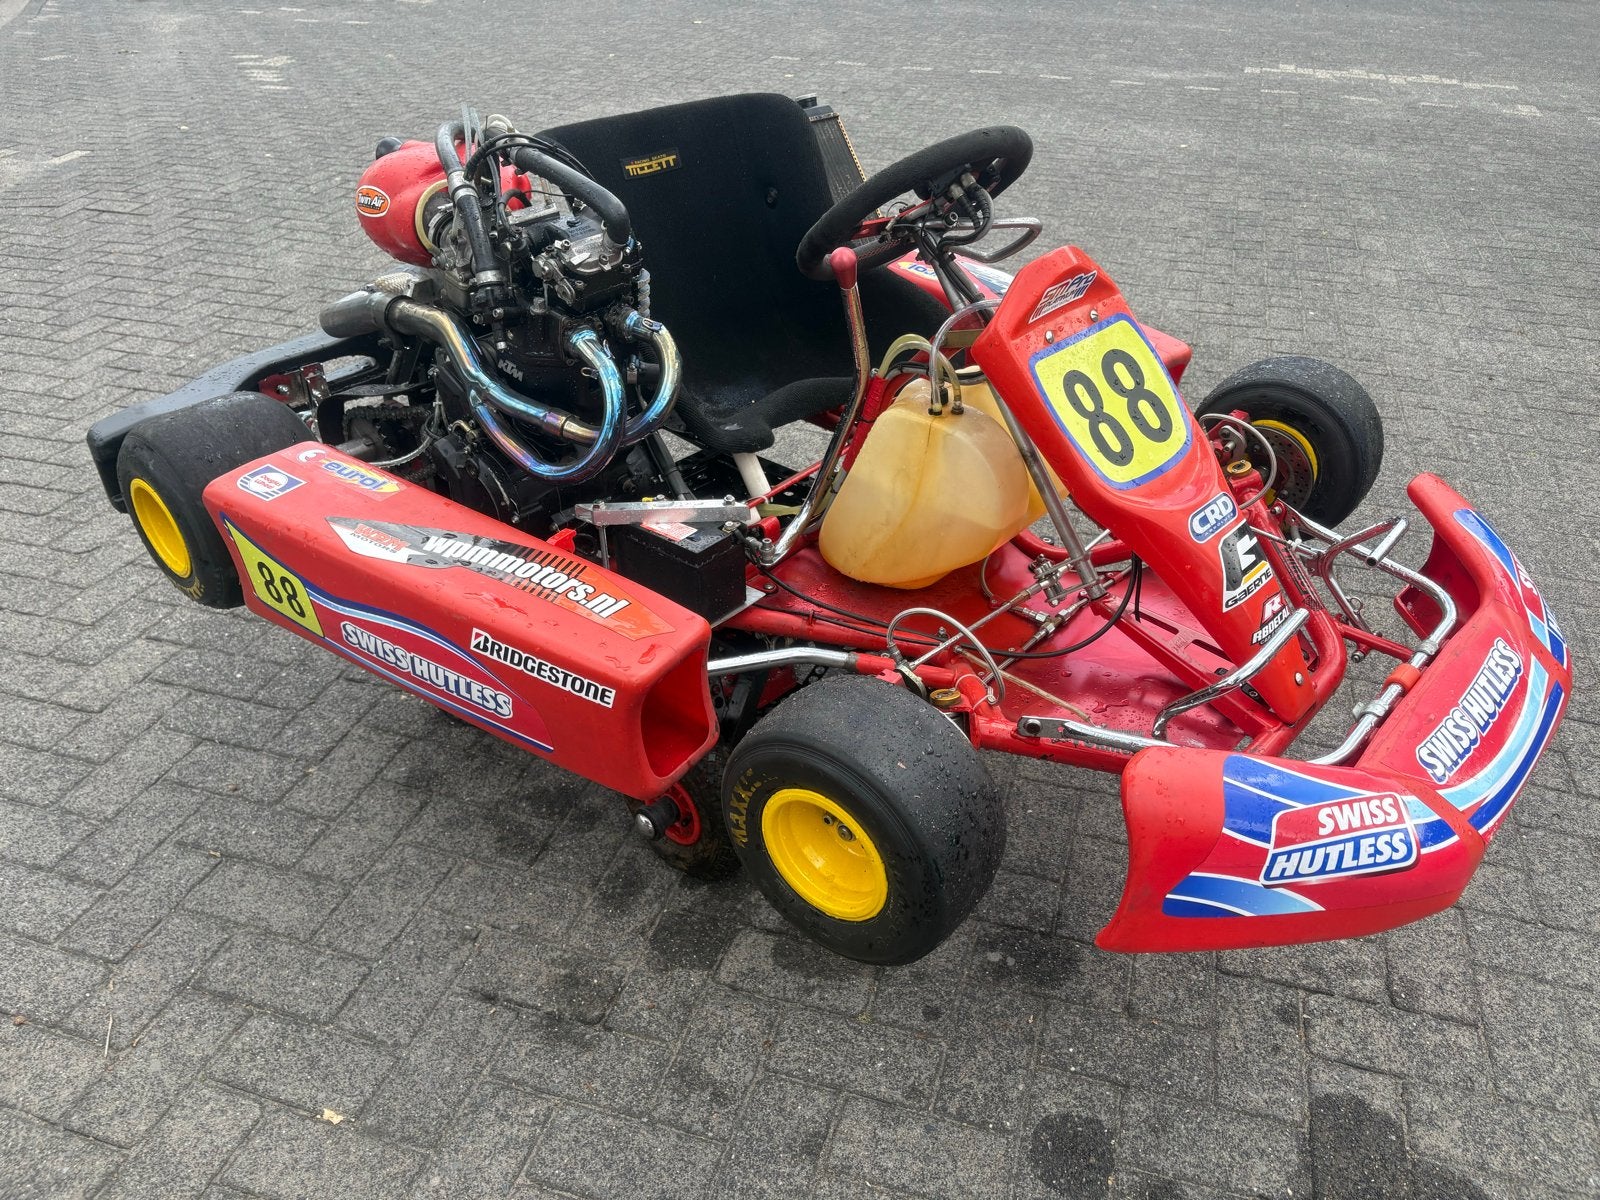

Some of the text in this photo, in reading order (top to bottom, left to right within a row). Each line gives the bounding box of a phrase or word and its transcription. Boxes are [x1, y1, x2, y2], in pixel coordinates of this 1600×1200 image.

[498, 359, 523, 382] KTM
[1062, 348, 1173, 467] 88
[322, 461, 388, 491] eurol
[1192, 495, 1234, 534] CRD
[350, 531, 398, 554] MOTORS
[256, 560, 306, 619] 88
[422, 535, 632, 619] wpmmotors.nl
[343, 623, 513, 718] SWISS HUTLESS
[473, 631, 614, 705] BRIDGESTONE
[1418, 639, 1523, 782] SWISS HUTLESS
[1318, 797, 1399, 836] SWISS
[1269, 831, 1408, 878] HUTLESS
